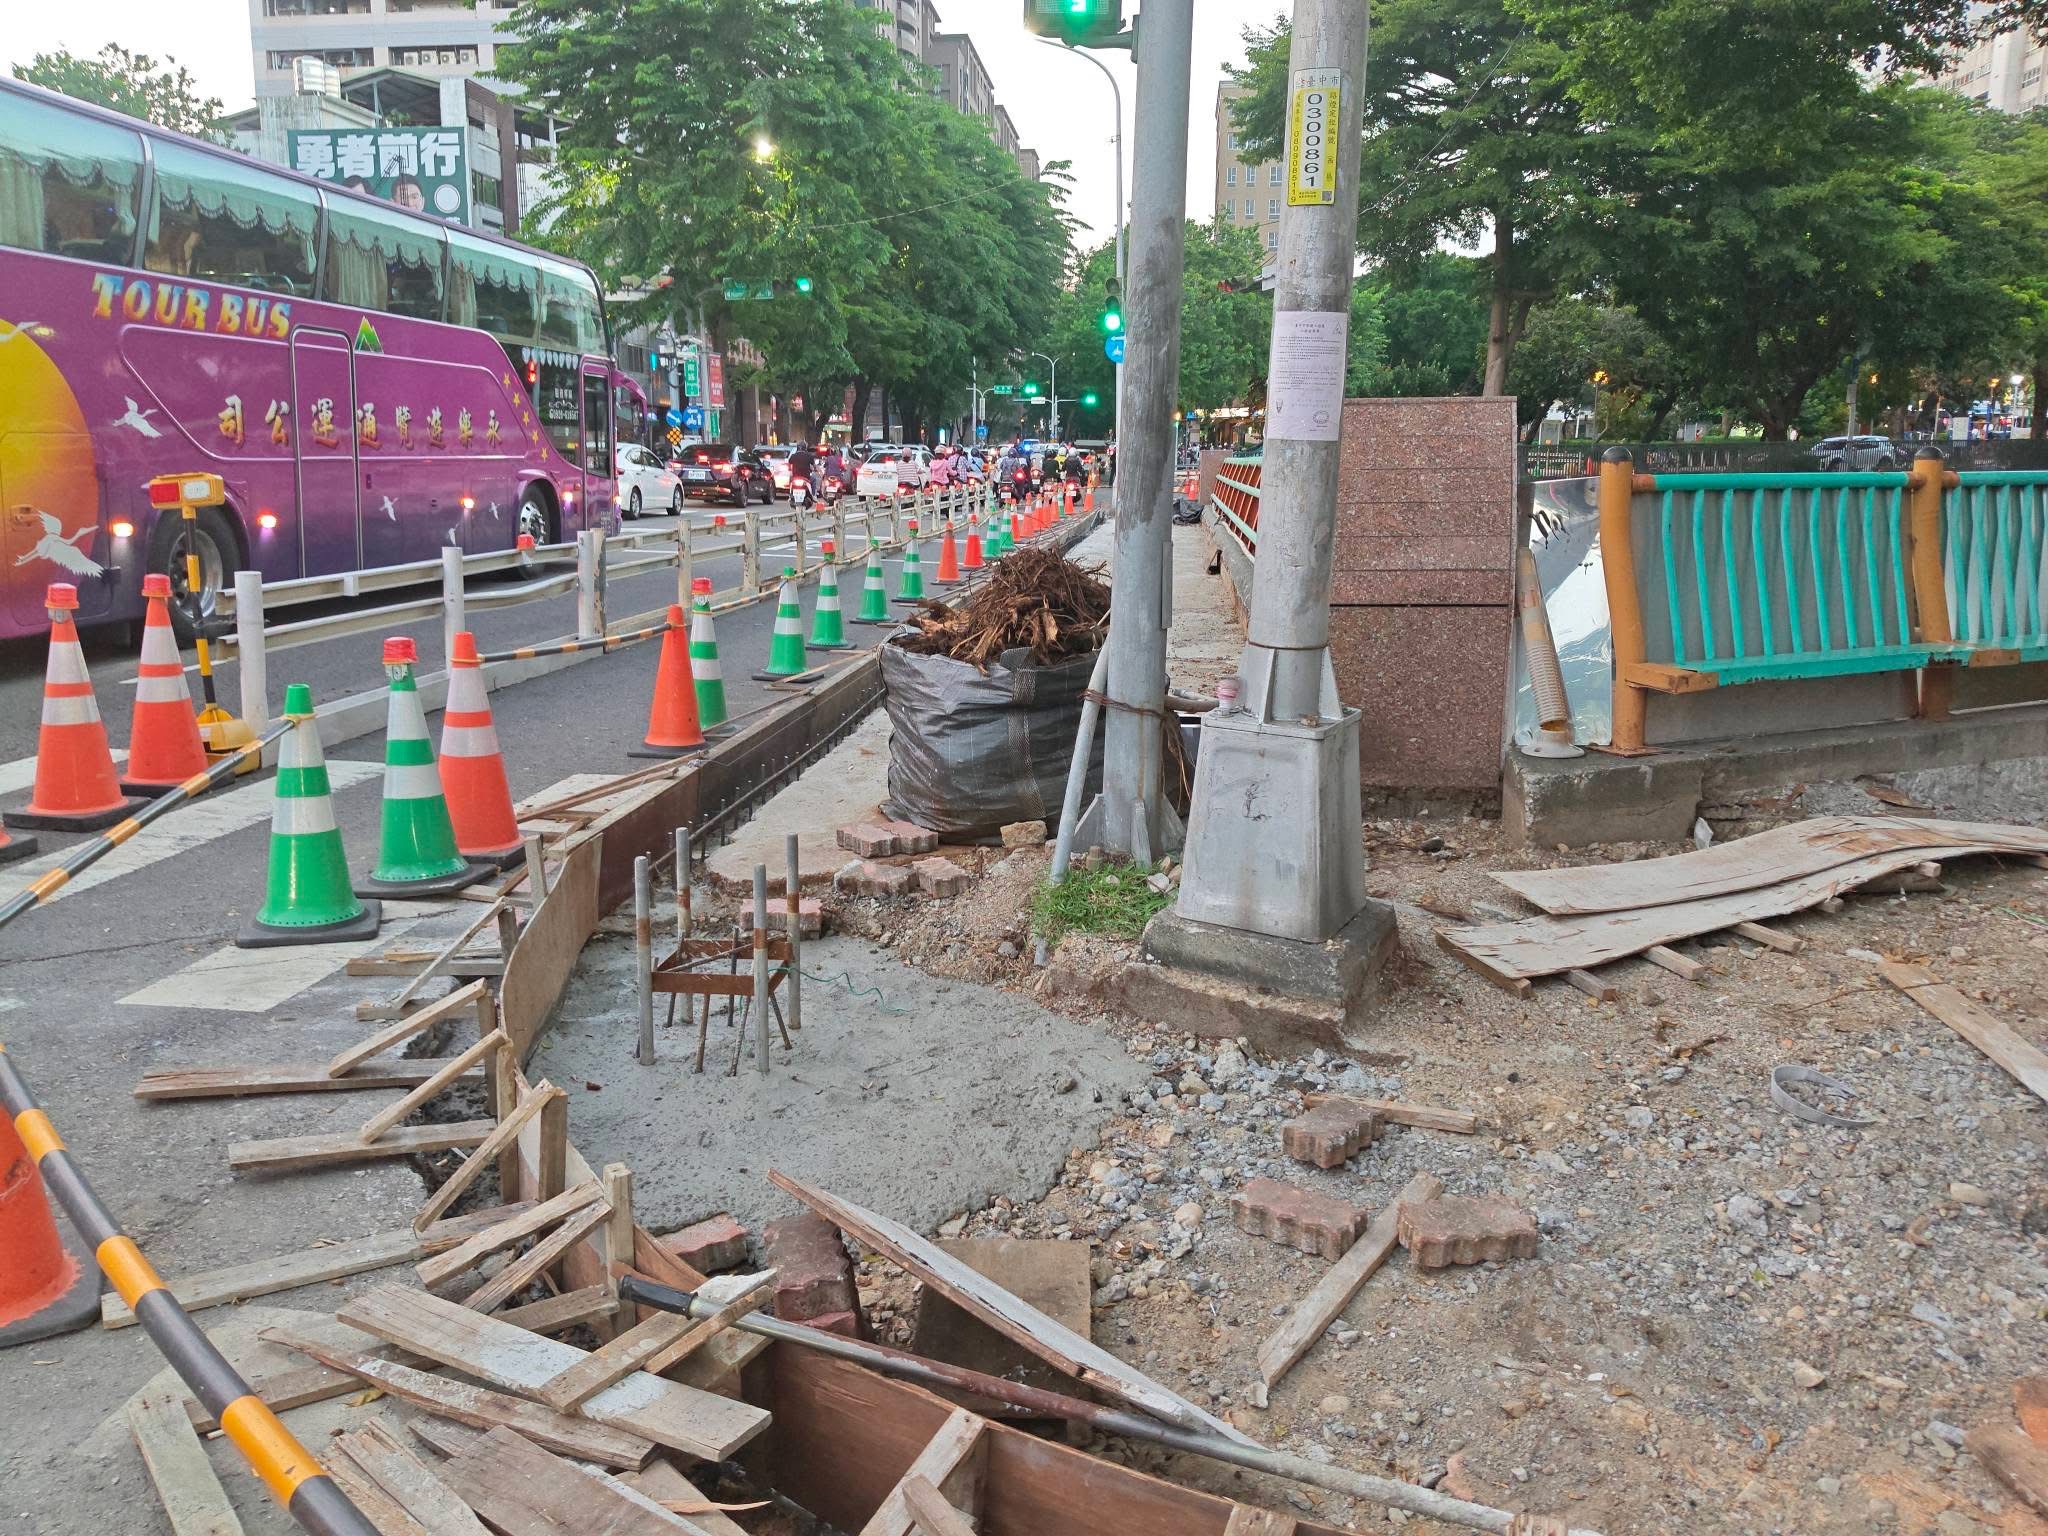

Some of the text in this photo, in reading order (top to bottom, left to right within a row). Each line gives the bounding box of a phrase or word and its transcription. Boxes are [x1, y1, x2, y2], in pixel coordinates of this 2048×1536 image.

[296, 132, 460, 179] 勇者前行
[1304, 93, 1323, 187] 0300861
[91, 272, 291, 339] TOUR BUS
